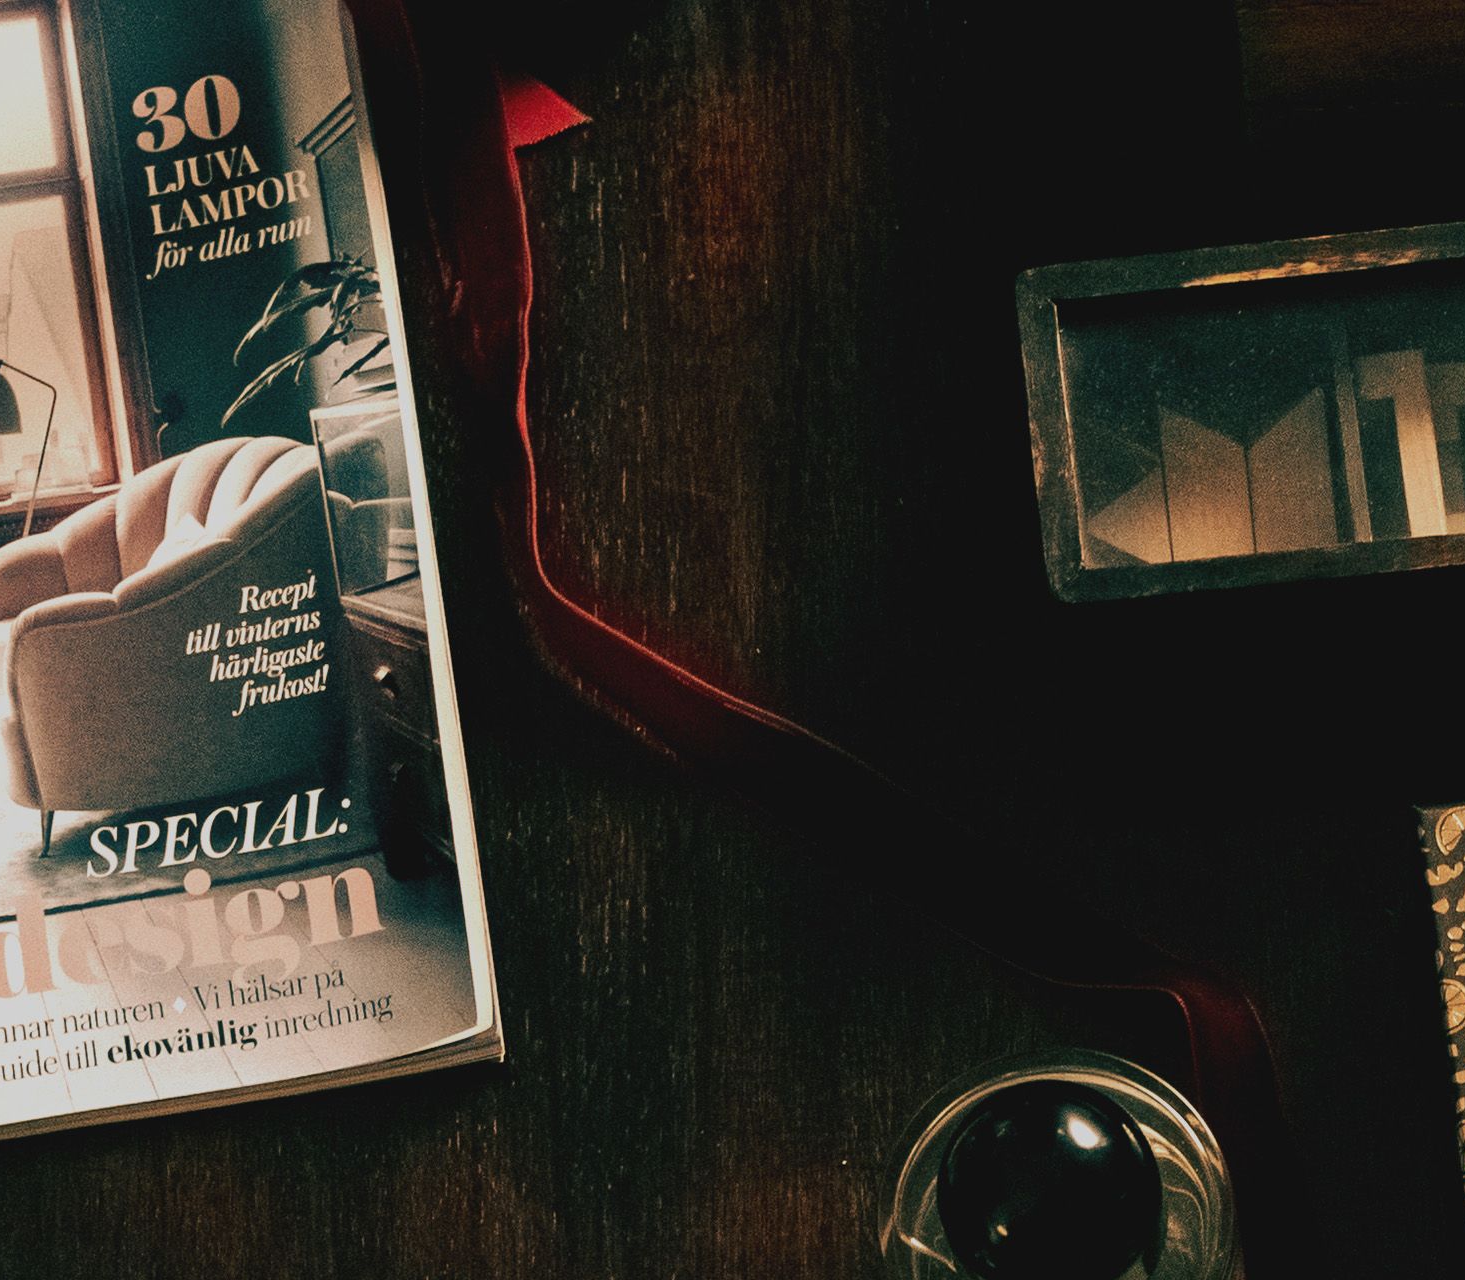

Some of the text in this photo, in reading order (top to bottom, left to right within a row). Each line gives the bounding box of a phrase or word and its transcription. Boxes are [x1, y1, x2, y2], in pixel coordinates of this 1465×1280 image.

[132, 75, 240, 152] 30
[144, 145, 261, 197] LJUVA
[151, 169, 311, 236] LAMPOR
[145, 215, 312, 280] för alla rum
[239, 573, 316, 614] Recept
[186, 611, 321, 655] till vinterns
[209, 639, 325, 682] härligaste
[232, 663, 330, 717] frukost!
[86, 787, 352, 879] SPECIAL:
[62, 1000, 166, 1035] naturen
[194, 984, 221, 1012] Vi
[228, 973, 308, 1006] hälsar
[315, 960, 346, 999] på
[66, 1040, 99, 1071] till
[107, 1019, 258, 1065] ekovänlig
[265, 992, 395, 1040] inredning
